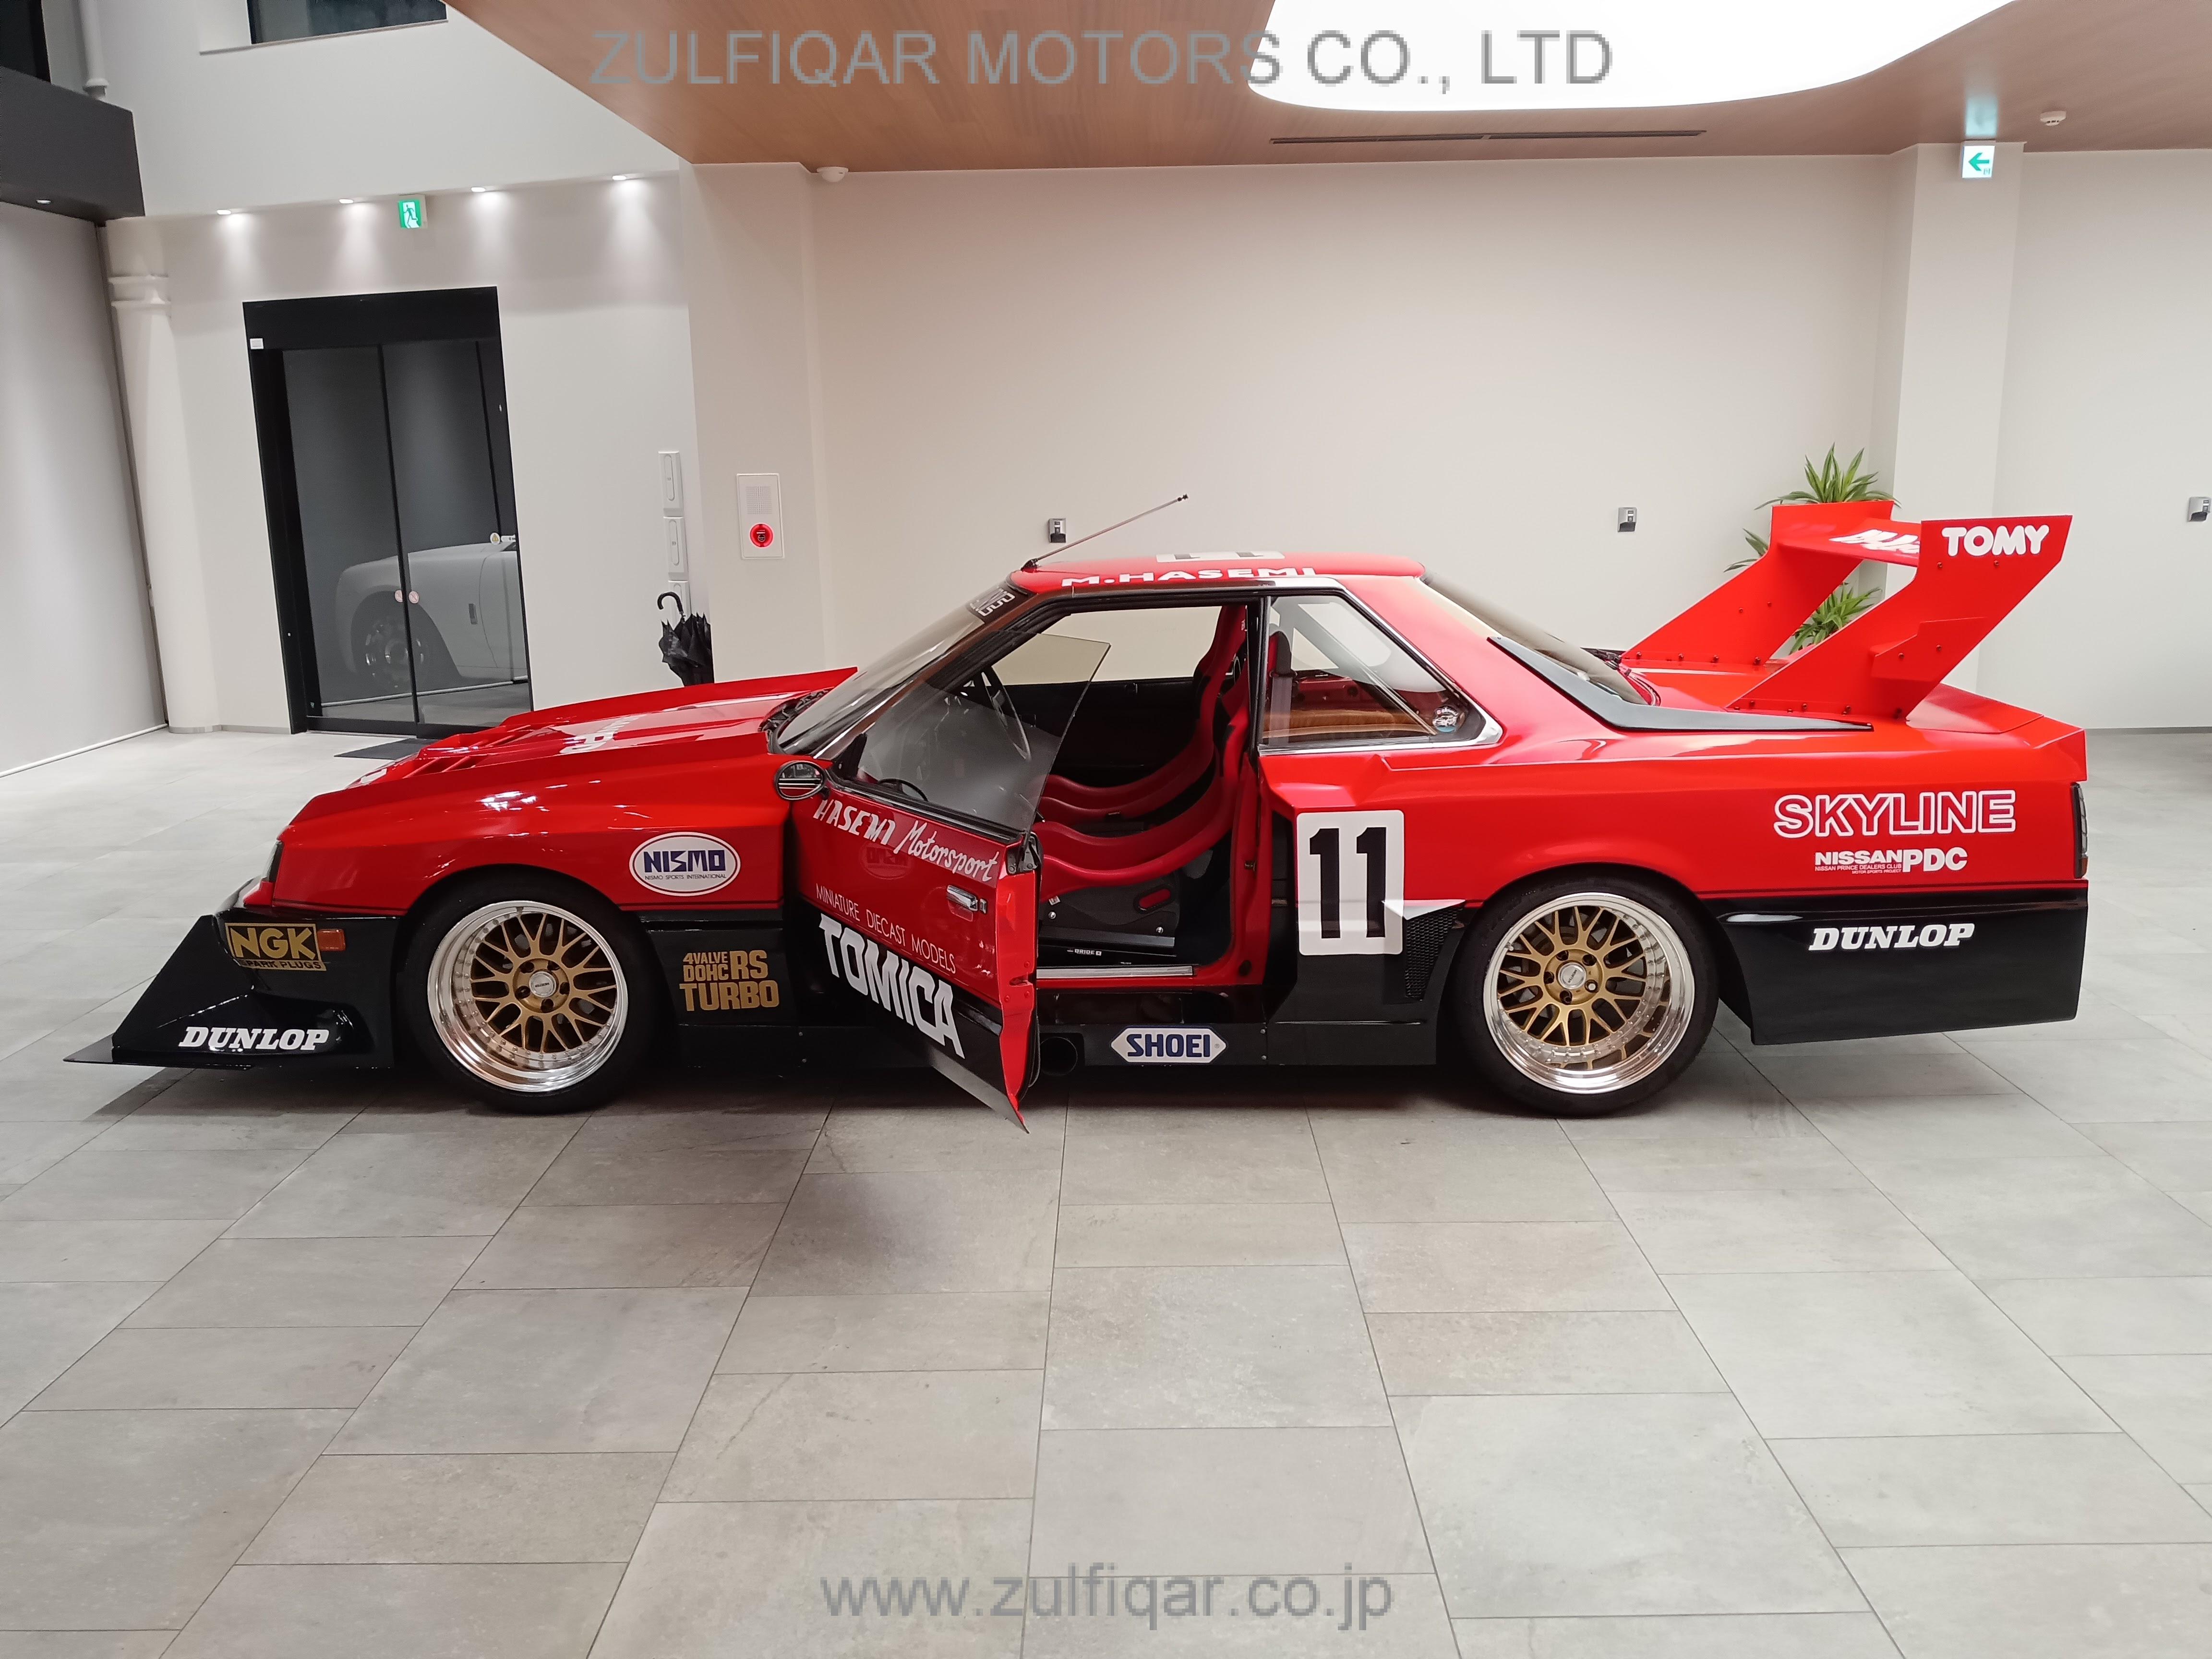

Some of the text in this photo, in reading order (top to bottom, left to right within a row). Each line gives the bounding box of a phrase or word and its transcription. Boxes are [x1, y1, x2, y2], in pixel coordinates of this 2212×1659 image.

[1941, 524, 2050, 557] TOMY
[1774, 790, 2016, 838] SKYLINE
[813, 800, 1000, 882] HASEMI Motorsport
[644, 850, 726, 873] NISMO
[1815, 847, 1968, 872] NISSAN PDC
[1309, 827, 1387, 939] 11
[230, 927, 316, 960] NGK
[816, 883, 956, 974] MINIATURE DIECAST MODELS
[1808, 923, 1975, 951] DUNLOP
[279, 961, 322, 969] PLUGS
[683, 951, 728, 964] 4VALVE
[683, 950, 768, 982] DOHC RS
[679, 980, 780, 1011] TURBO
[819, 913, 965, 1059] TOMICA
[178, 1026, 330, 1050] DUNLOP
[1126, 1034, 1211, 1058] SHOEI
